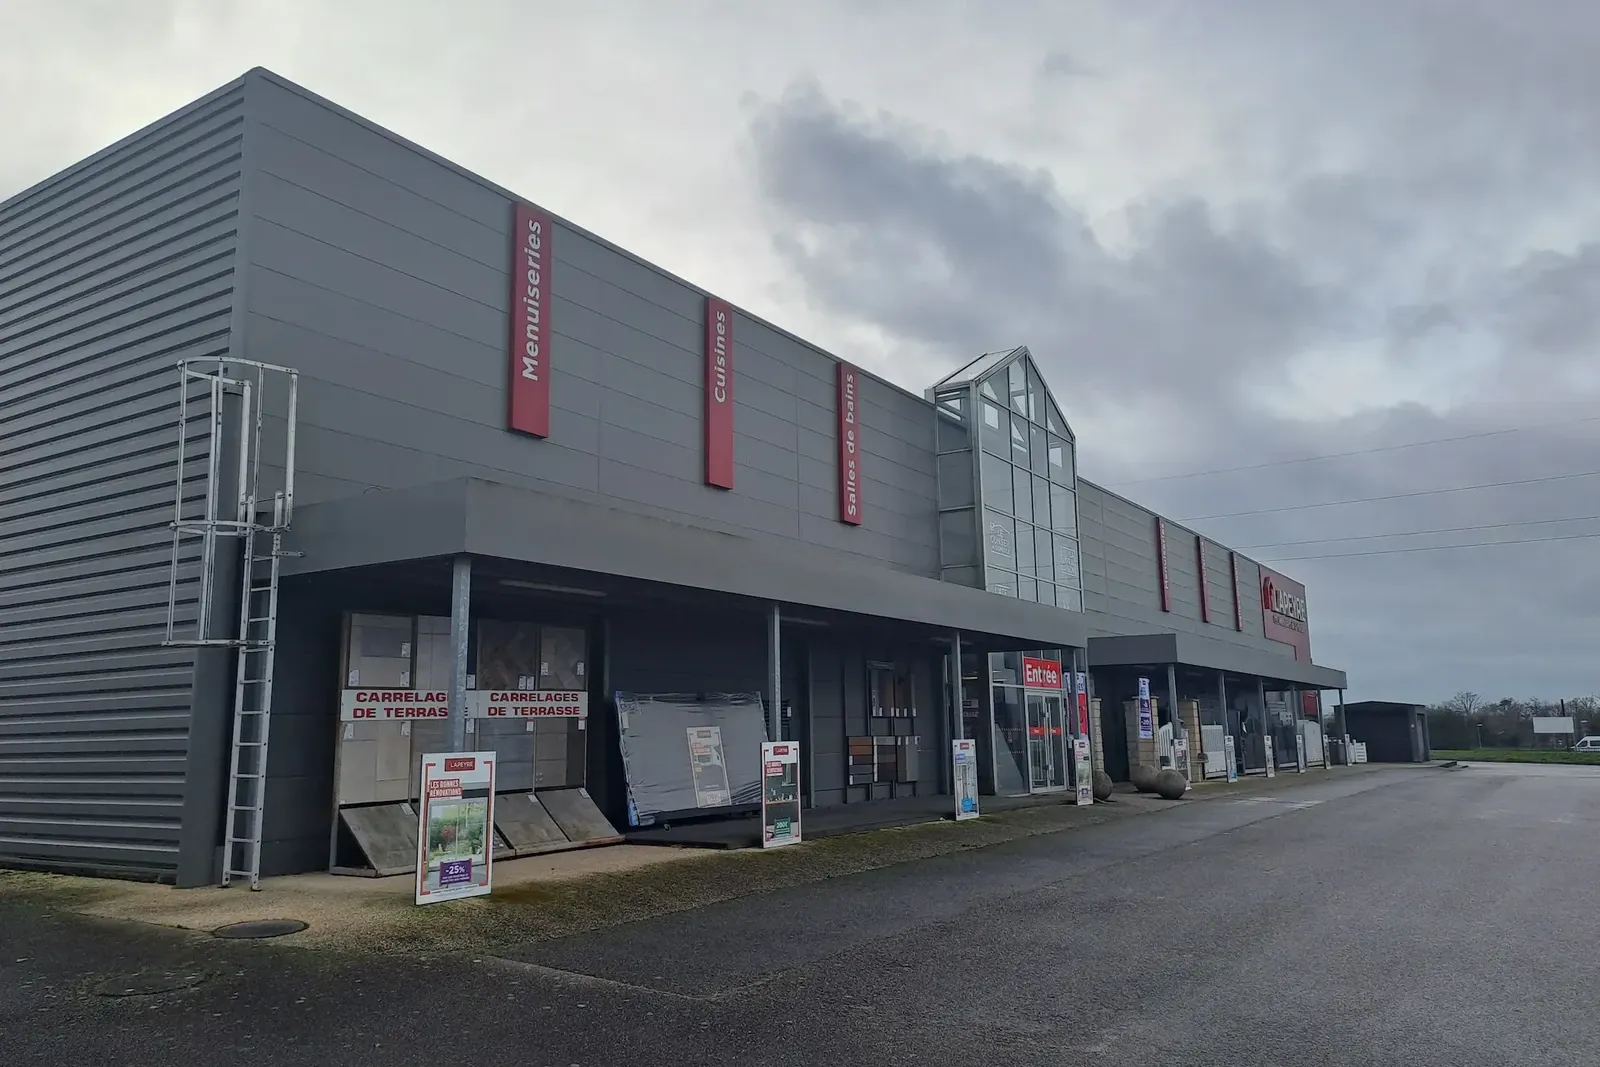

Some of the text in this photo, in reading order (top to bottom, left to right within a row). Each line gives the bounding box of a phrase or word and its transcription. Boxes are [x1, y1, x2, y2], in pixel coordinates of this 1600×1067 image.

[522, 219, 542, 381] Menuiseries
[714, 310, 726, 403] Cuisines
[845, 373, 857, 516] Salles de bains
[1026, 664, 1057, 683] Entrée
[356, 692, 448, 702] CARRELAG
[490, 692, 579, 702] CARRELAGES
[353, 707, 448, 718] DE TERRAS
[487, 706, 580, 716] DE TERRASSE
[445, 865, 466, 874] -25%
